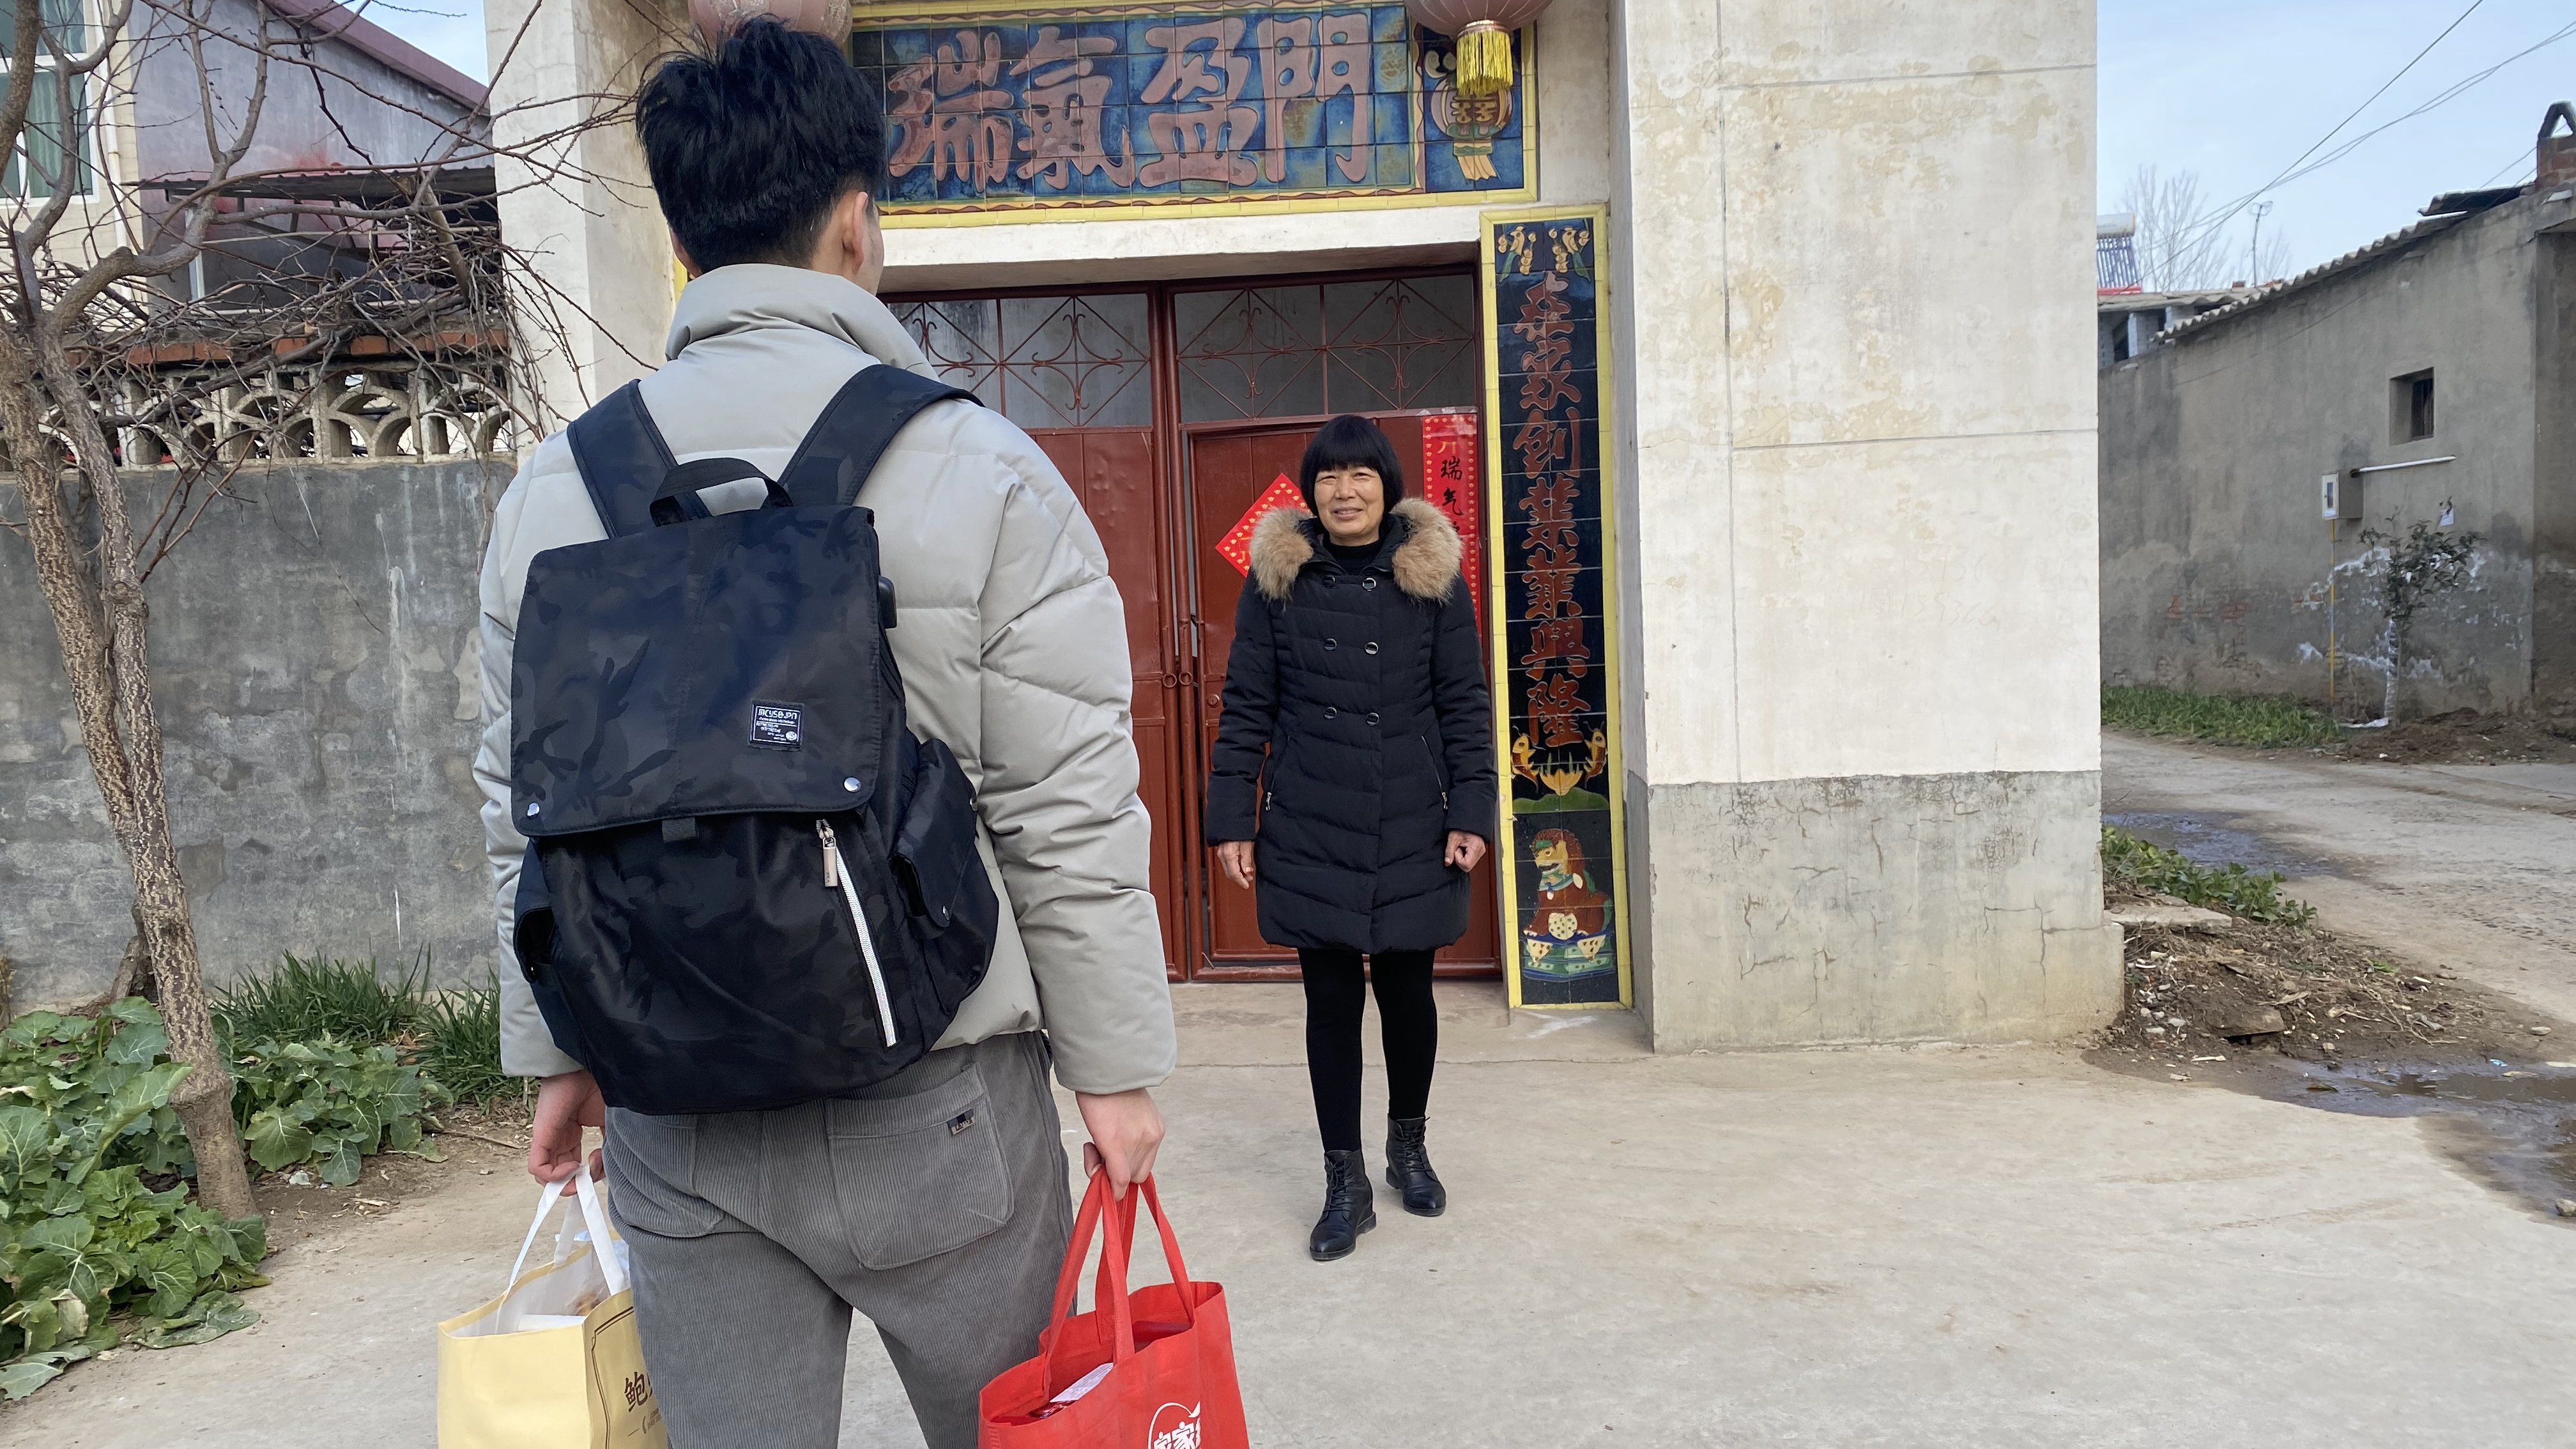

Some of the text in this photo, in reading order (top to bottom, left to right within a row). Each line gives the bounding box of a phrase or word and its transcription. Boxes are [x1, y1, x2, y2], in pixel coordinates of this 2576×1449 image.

[1440, 456, 1464, 533] 瑞气
[624, 1371, 653, 1413] 鲍
[1154, 1421, 1201, 1449] 家家
